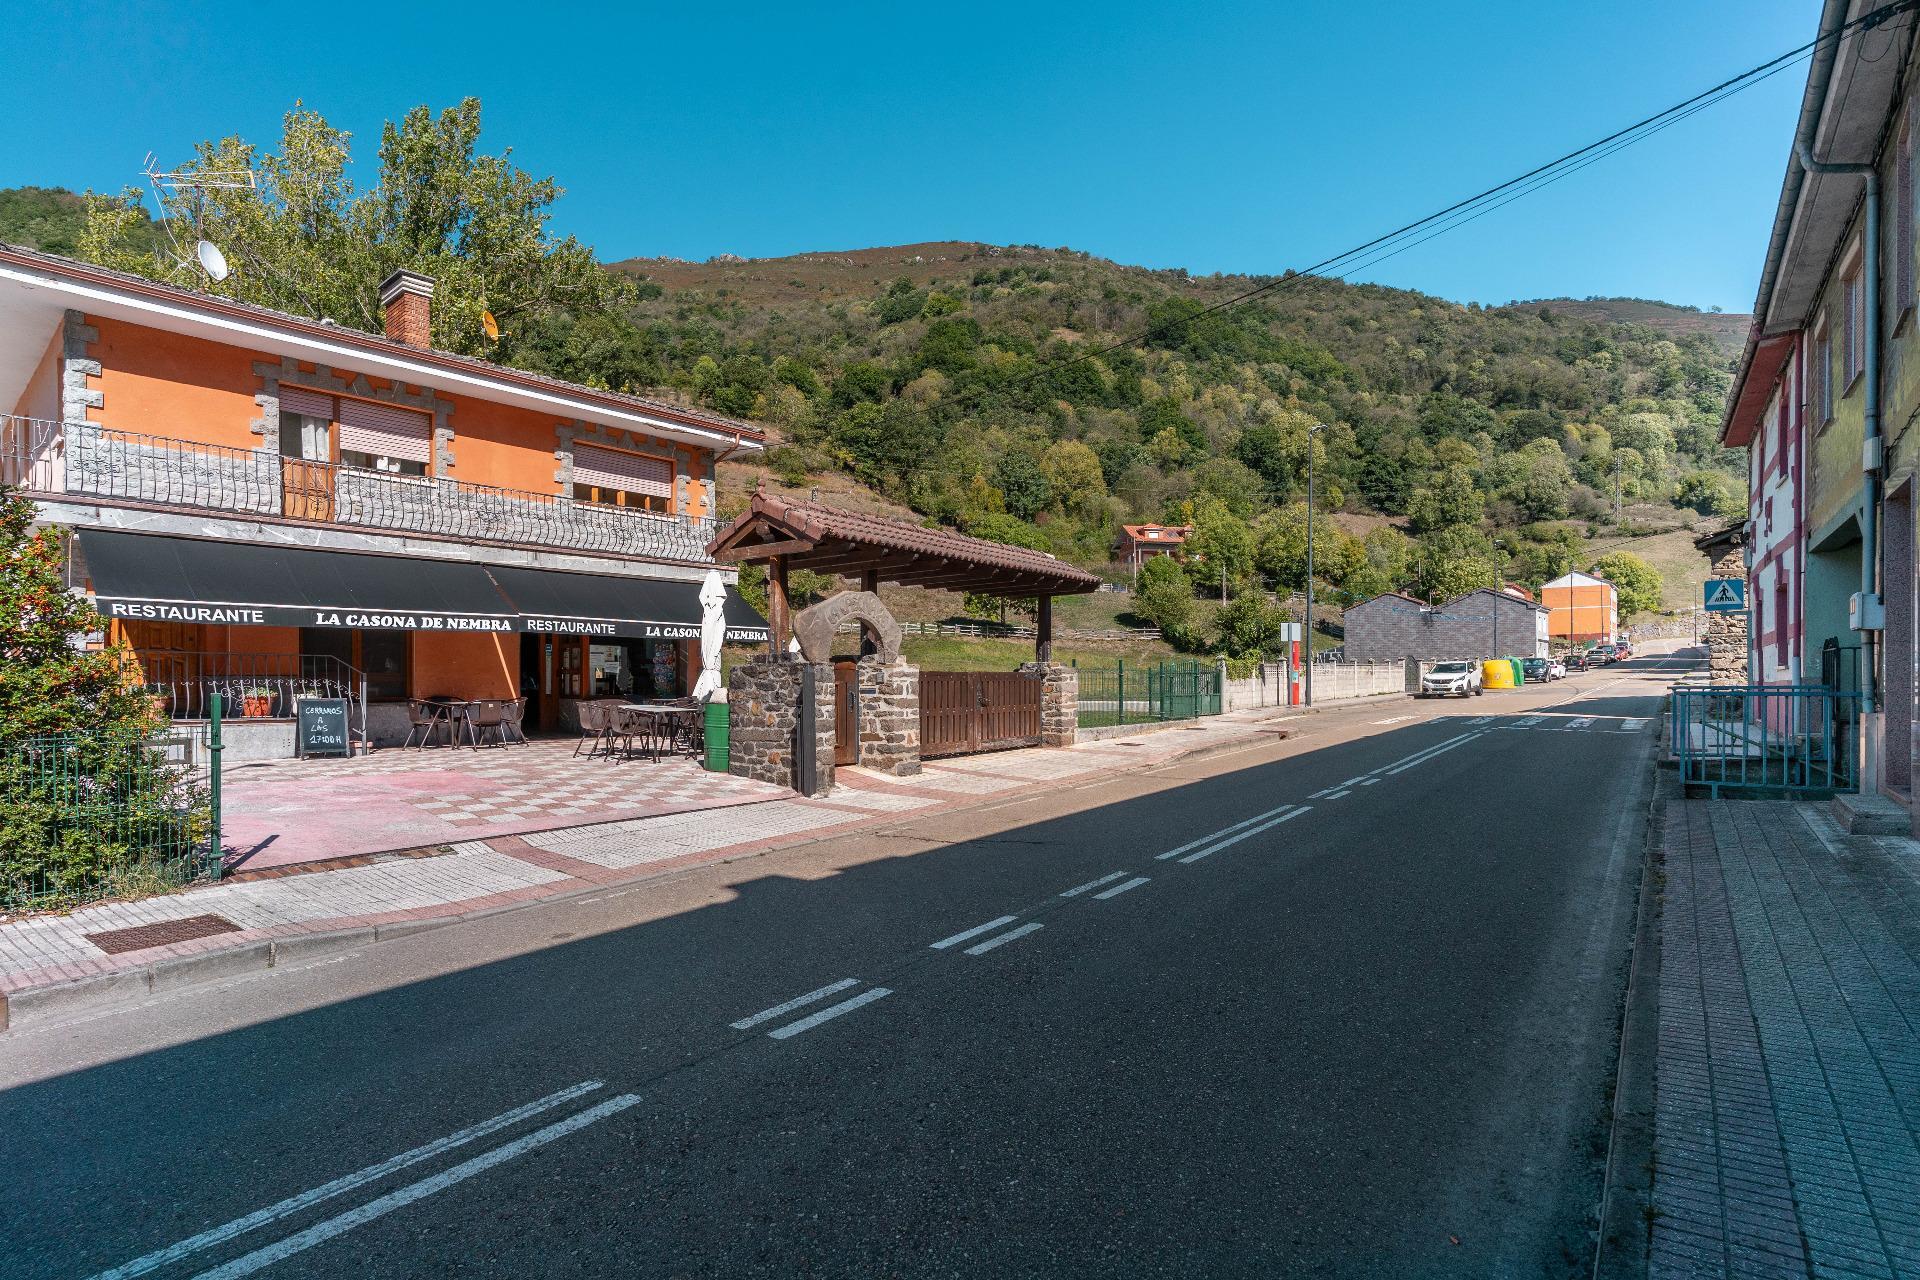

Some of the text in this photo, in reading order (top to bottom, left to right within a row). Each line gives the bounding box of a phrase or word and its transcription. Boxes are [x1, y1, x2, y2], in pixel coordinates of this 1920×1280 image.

[112, 603, 265, 623] RESTAURANTE
[315, 612, 511, 631] LA CASONA DE NEMBRA
[527, 619, 616, 635] RESTAURANTE
[645, 626, 768, 641] LA CASON NEMBRA
[317, 716, 324, 724] A
[310, 724, 329, 732] LAS
